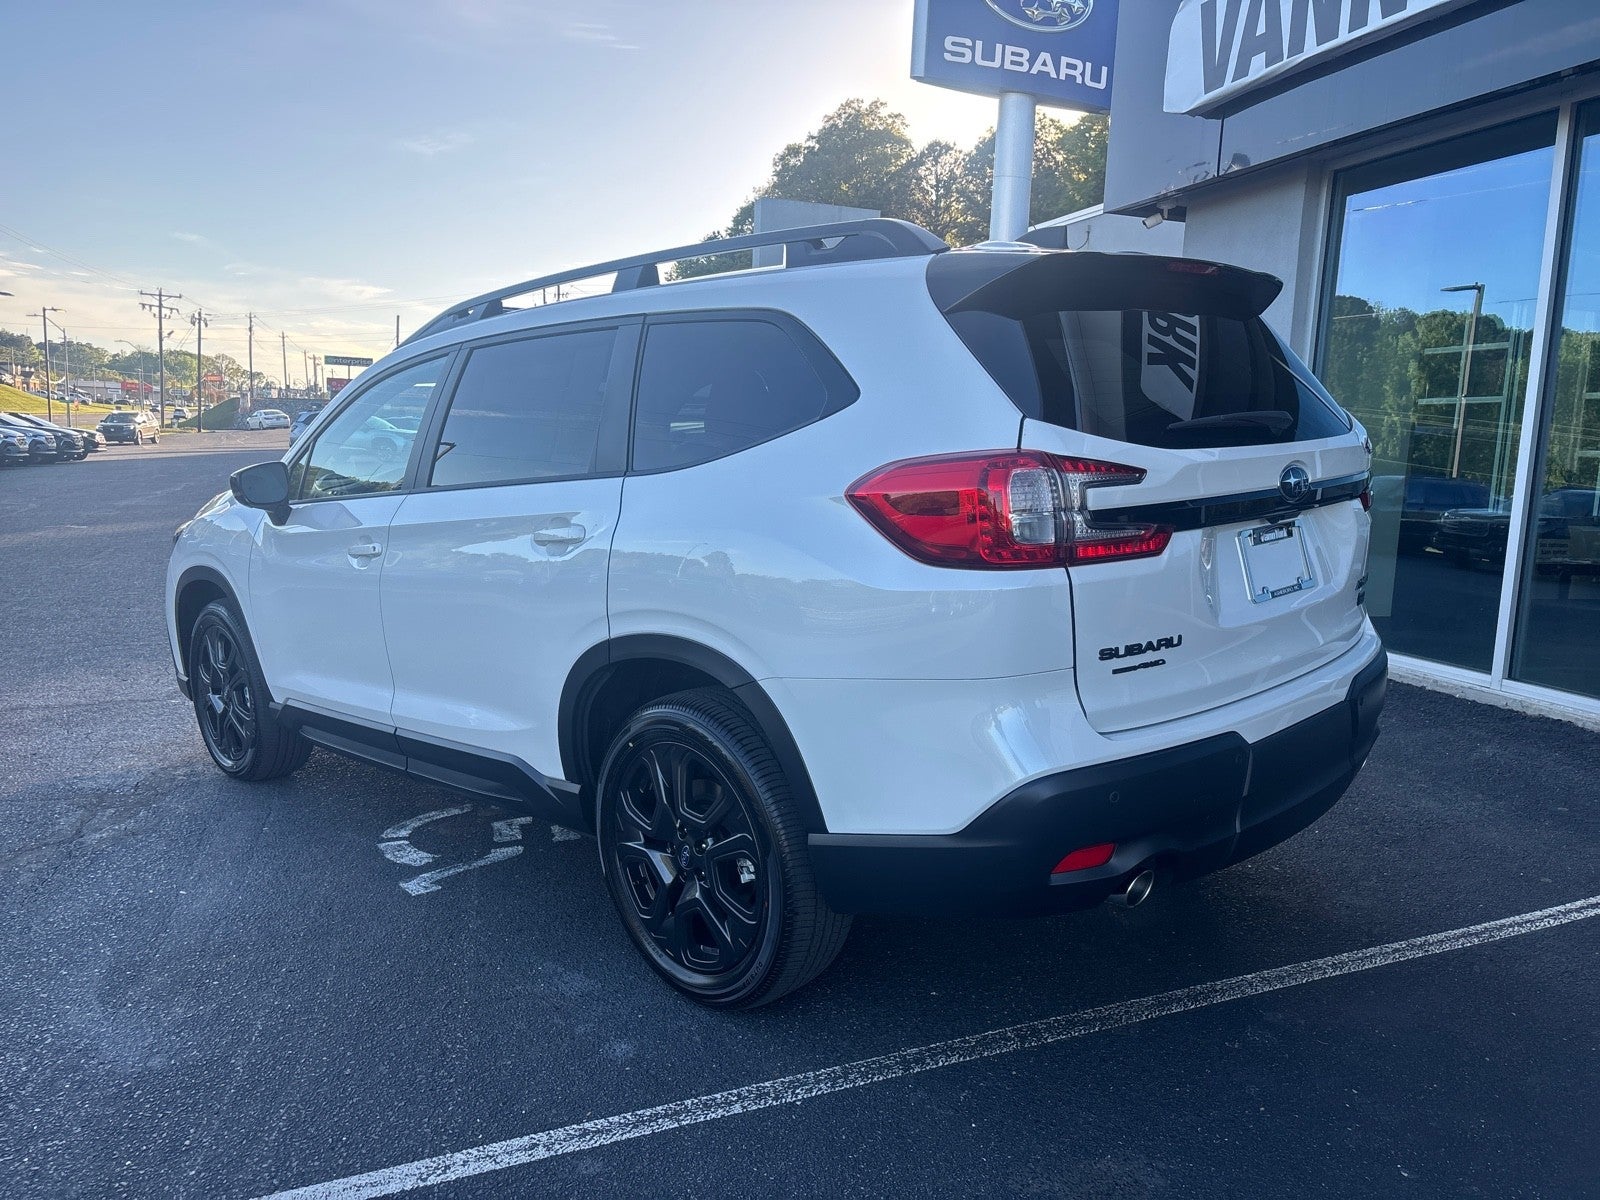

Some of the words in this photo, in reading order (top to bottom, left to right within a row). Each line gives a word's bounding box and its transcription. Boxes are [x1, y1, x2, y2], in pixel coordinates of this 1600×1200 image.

[943, 35, 1108, 90] SUBARU
[1201, 0, 1408, 95] VAN
[327, 356, 373, 366] enterprise
[1098, 634, 1183, 661] SUBARU
